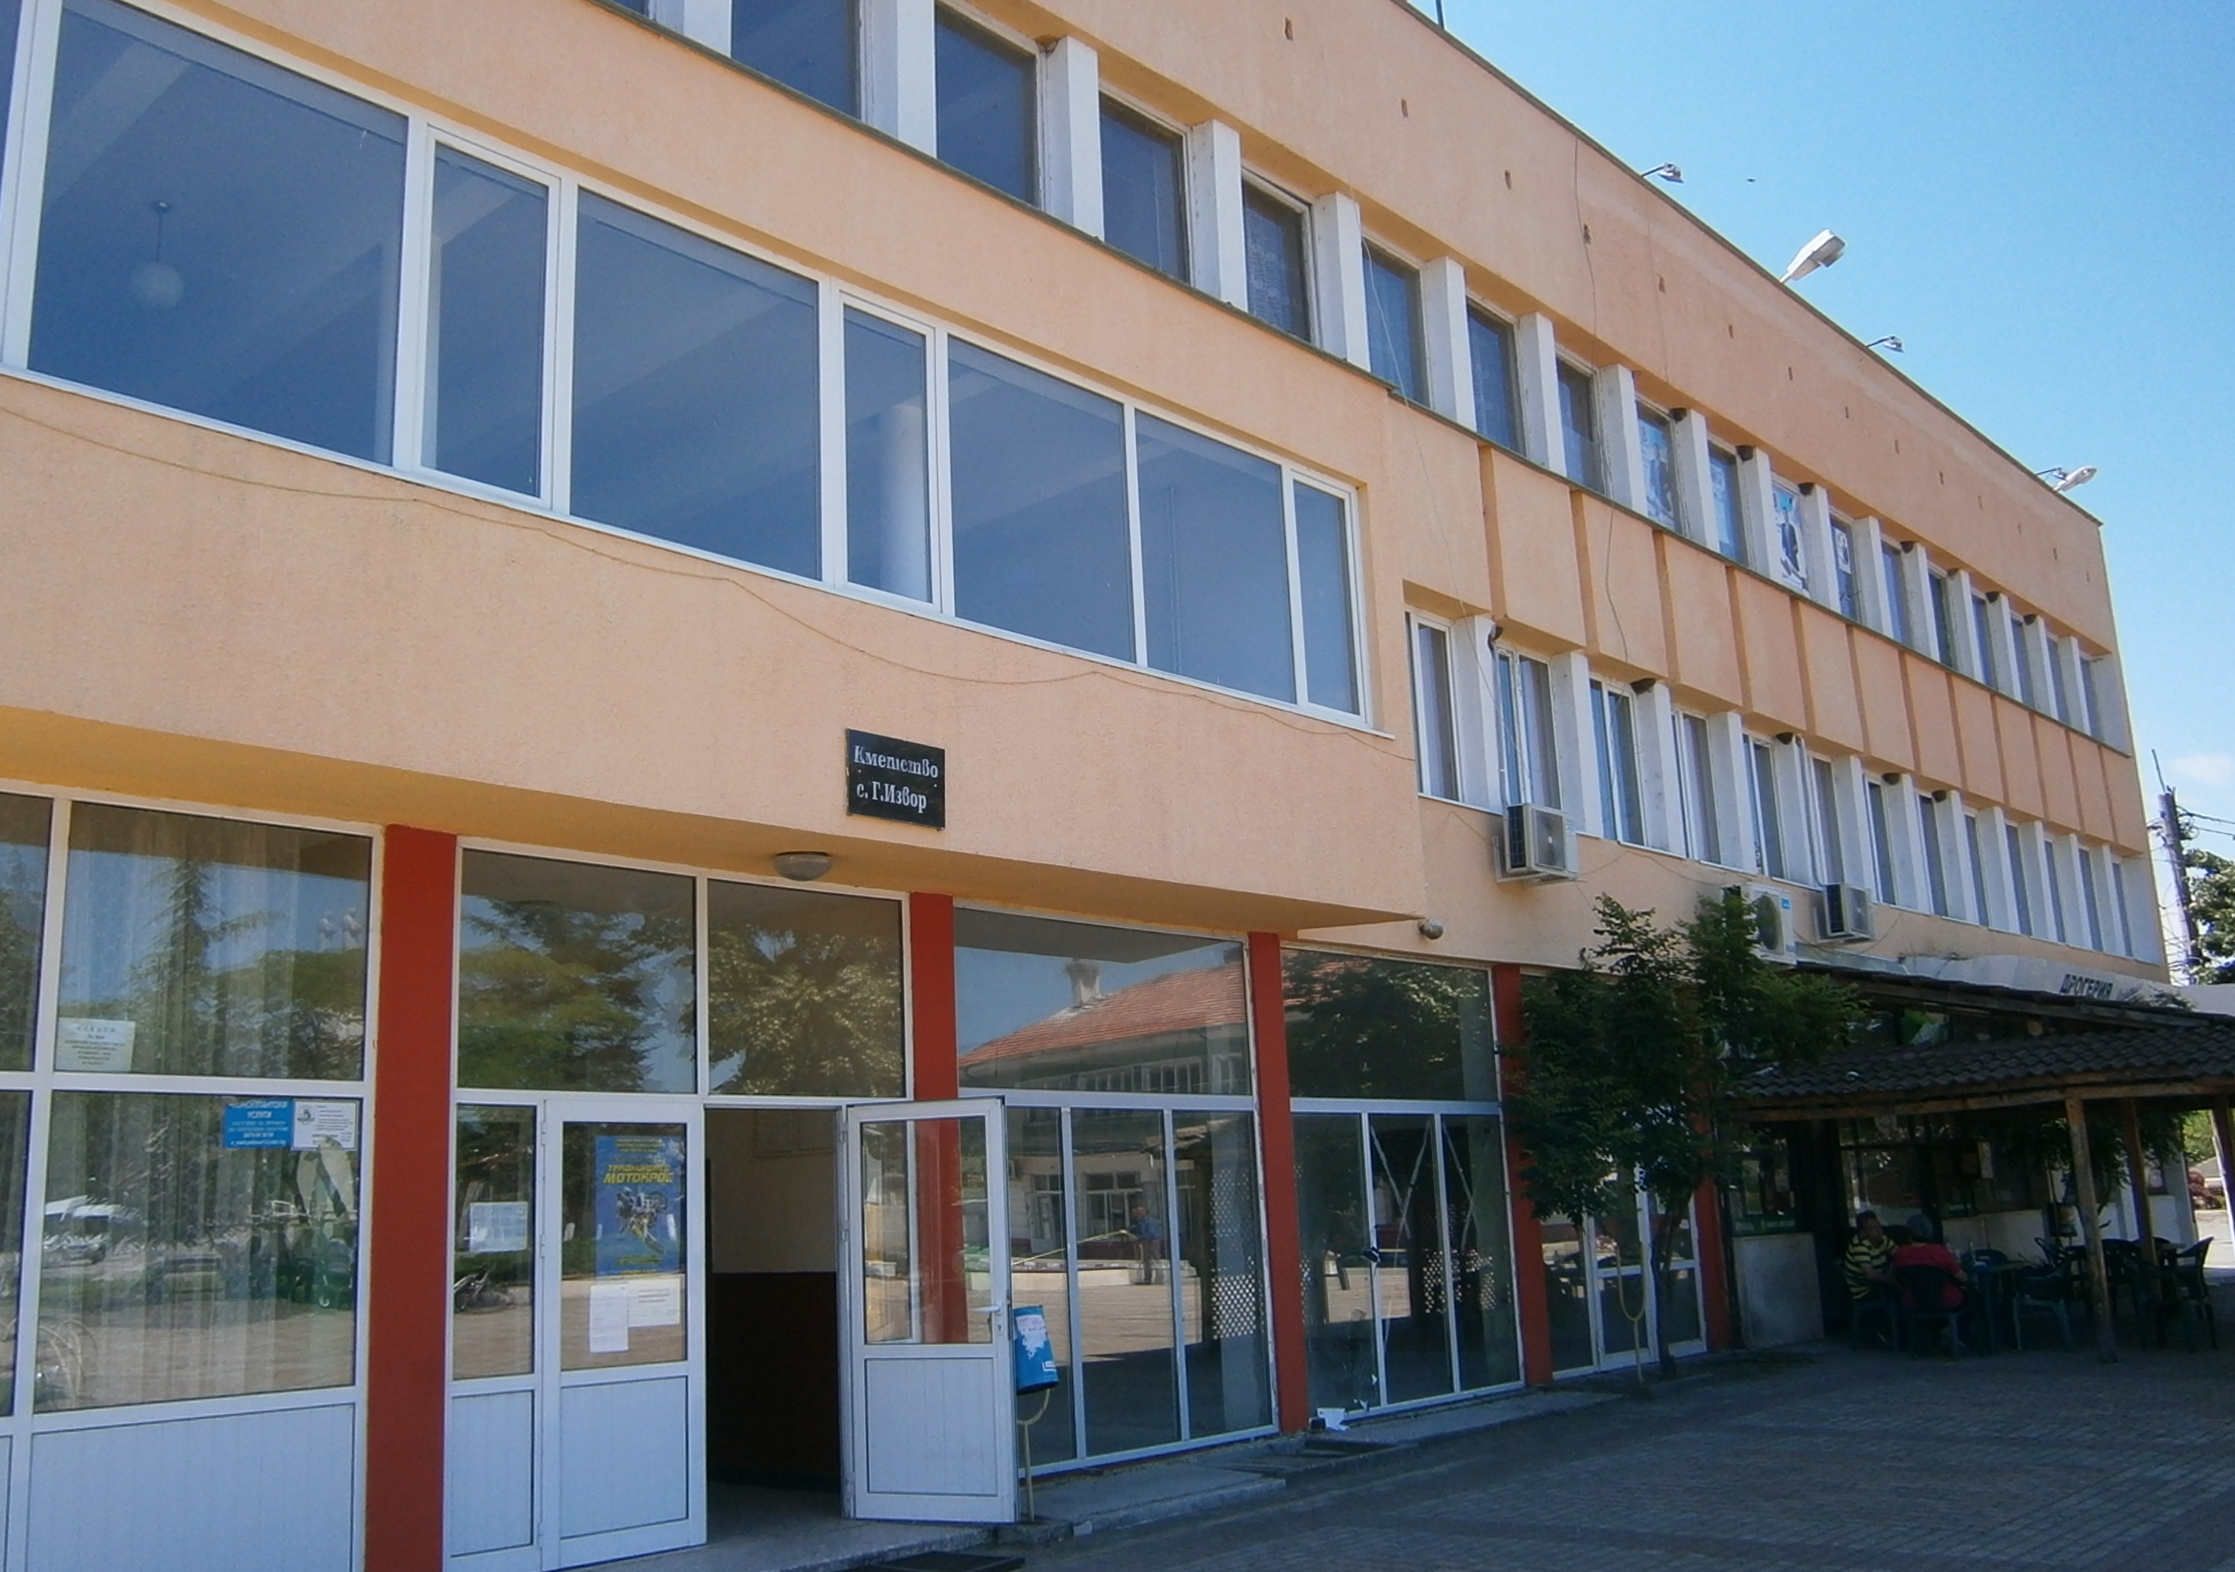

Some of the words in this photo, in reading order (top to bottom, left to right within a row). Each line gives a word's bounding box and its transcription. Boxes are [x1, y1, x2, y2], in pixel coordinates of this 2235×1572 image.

[853, 744, 939, 778] Кметство
[856, 783, 869, 799] с.
[872, 781, 927, 814] Г.Извор
[603, 1172, 675, 1184] МОТОКРОС
